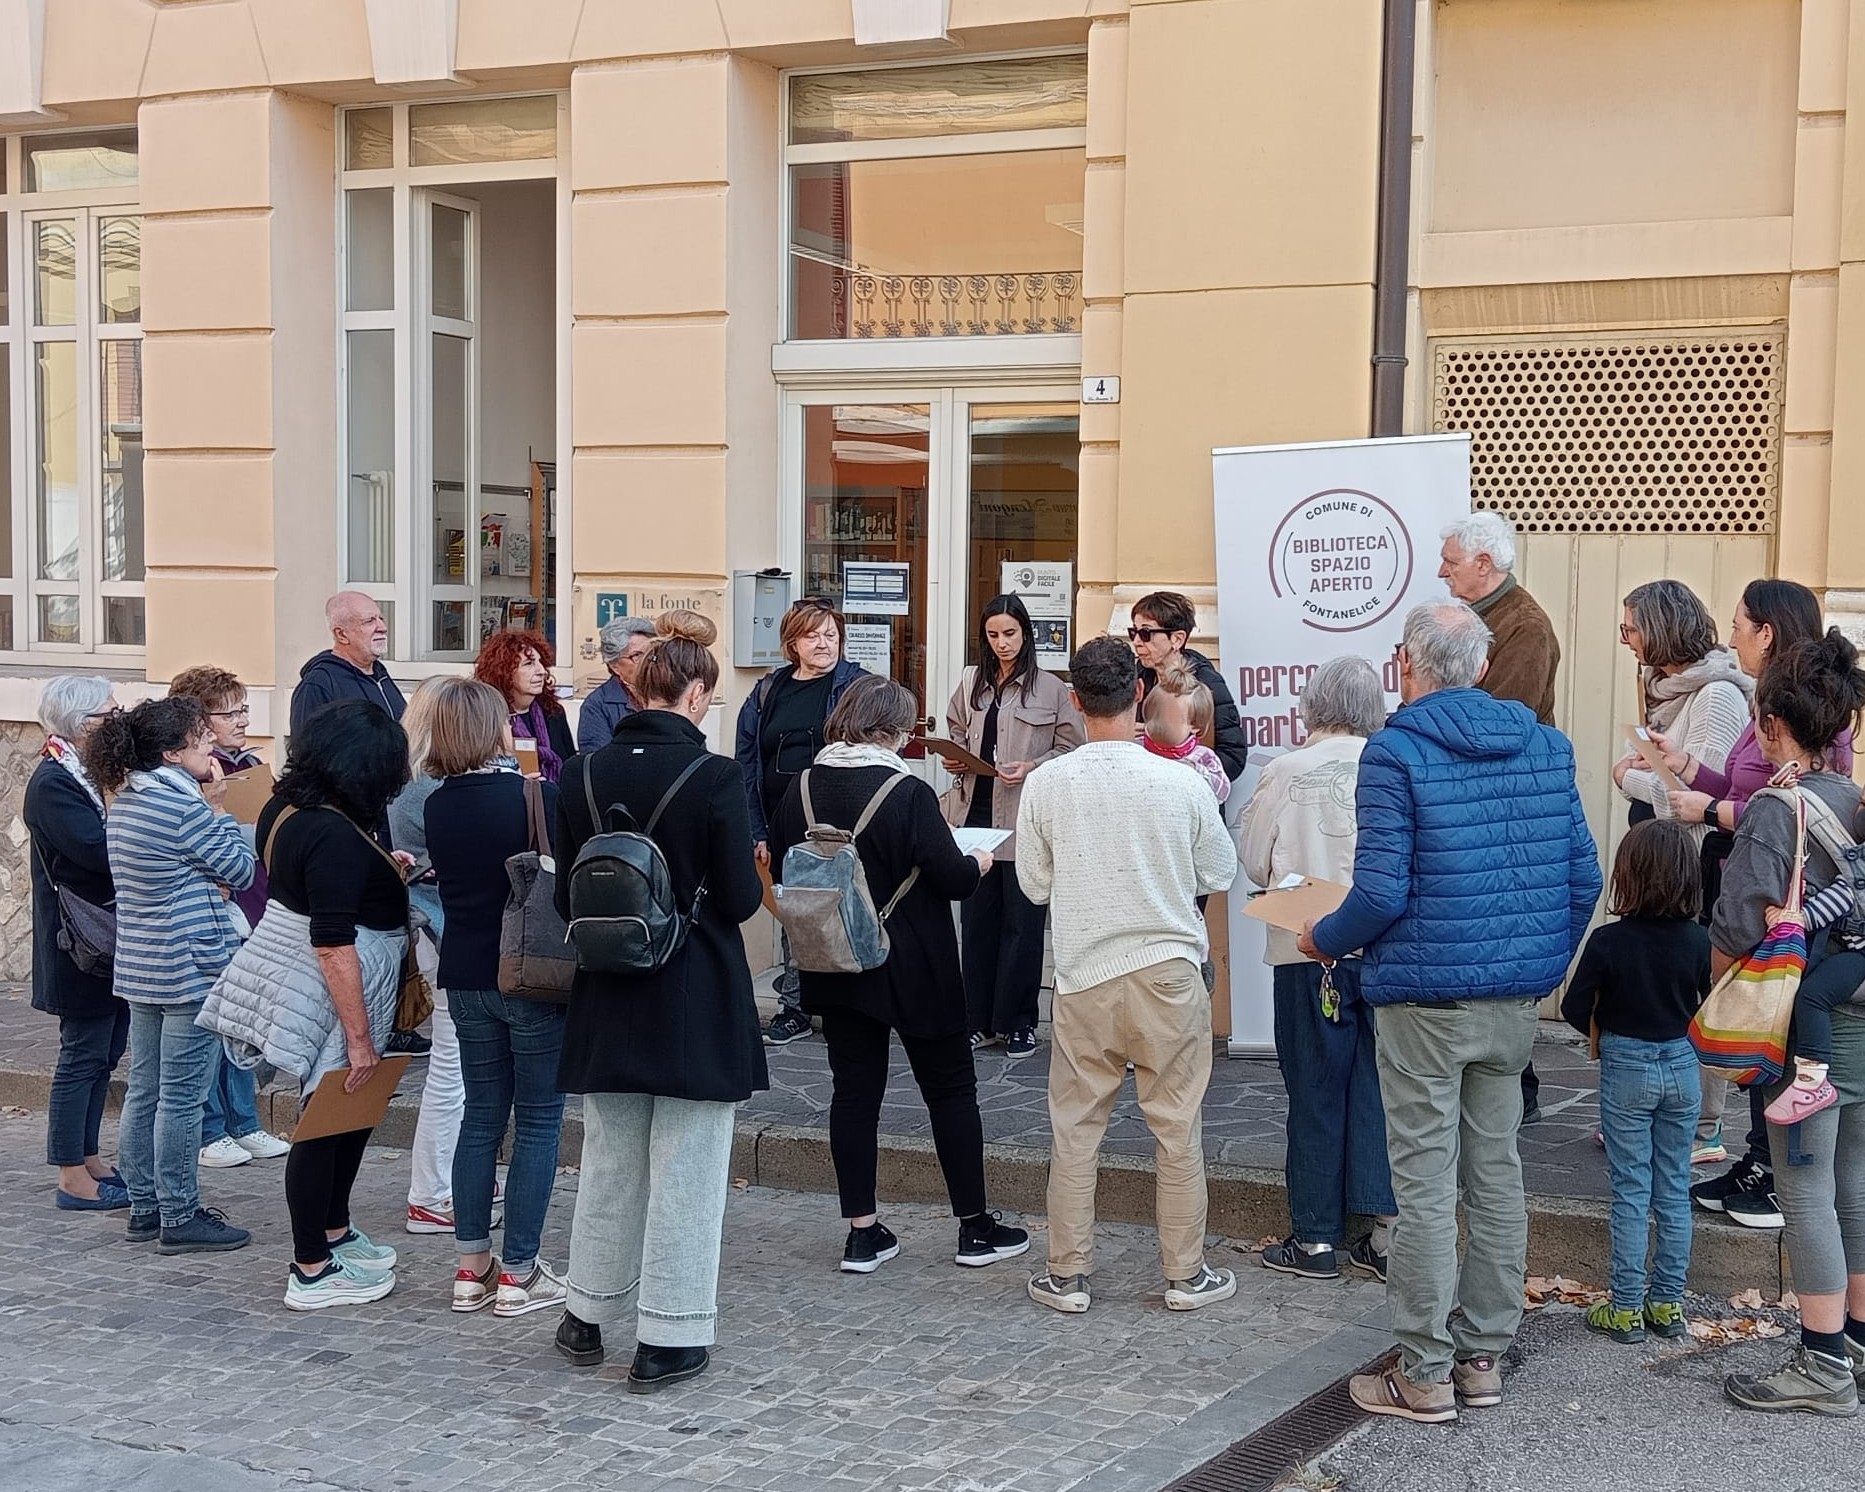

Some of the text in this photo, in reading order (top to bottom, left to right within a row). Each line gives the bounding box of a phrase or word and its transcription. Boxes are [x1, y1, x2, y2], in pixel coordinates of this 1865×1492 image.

[1096, 379, 1106, 395] 4
[1305, 501, 1374, 520] COMUNE DI
[1293, 535, 1389, 554] BIBLIOTECA
[1311, 556, 1371, 573] SPAZIO
[1310, 576, 1373, 593] APERTO
[641, 593, 702, 610] la fonte
[1302, 596, 1381, 619] FONTANELICE
